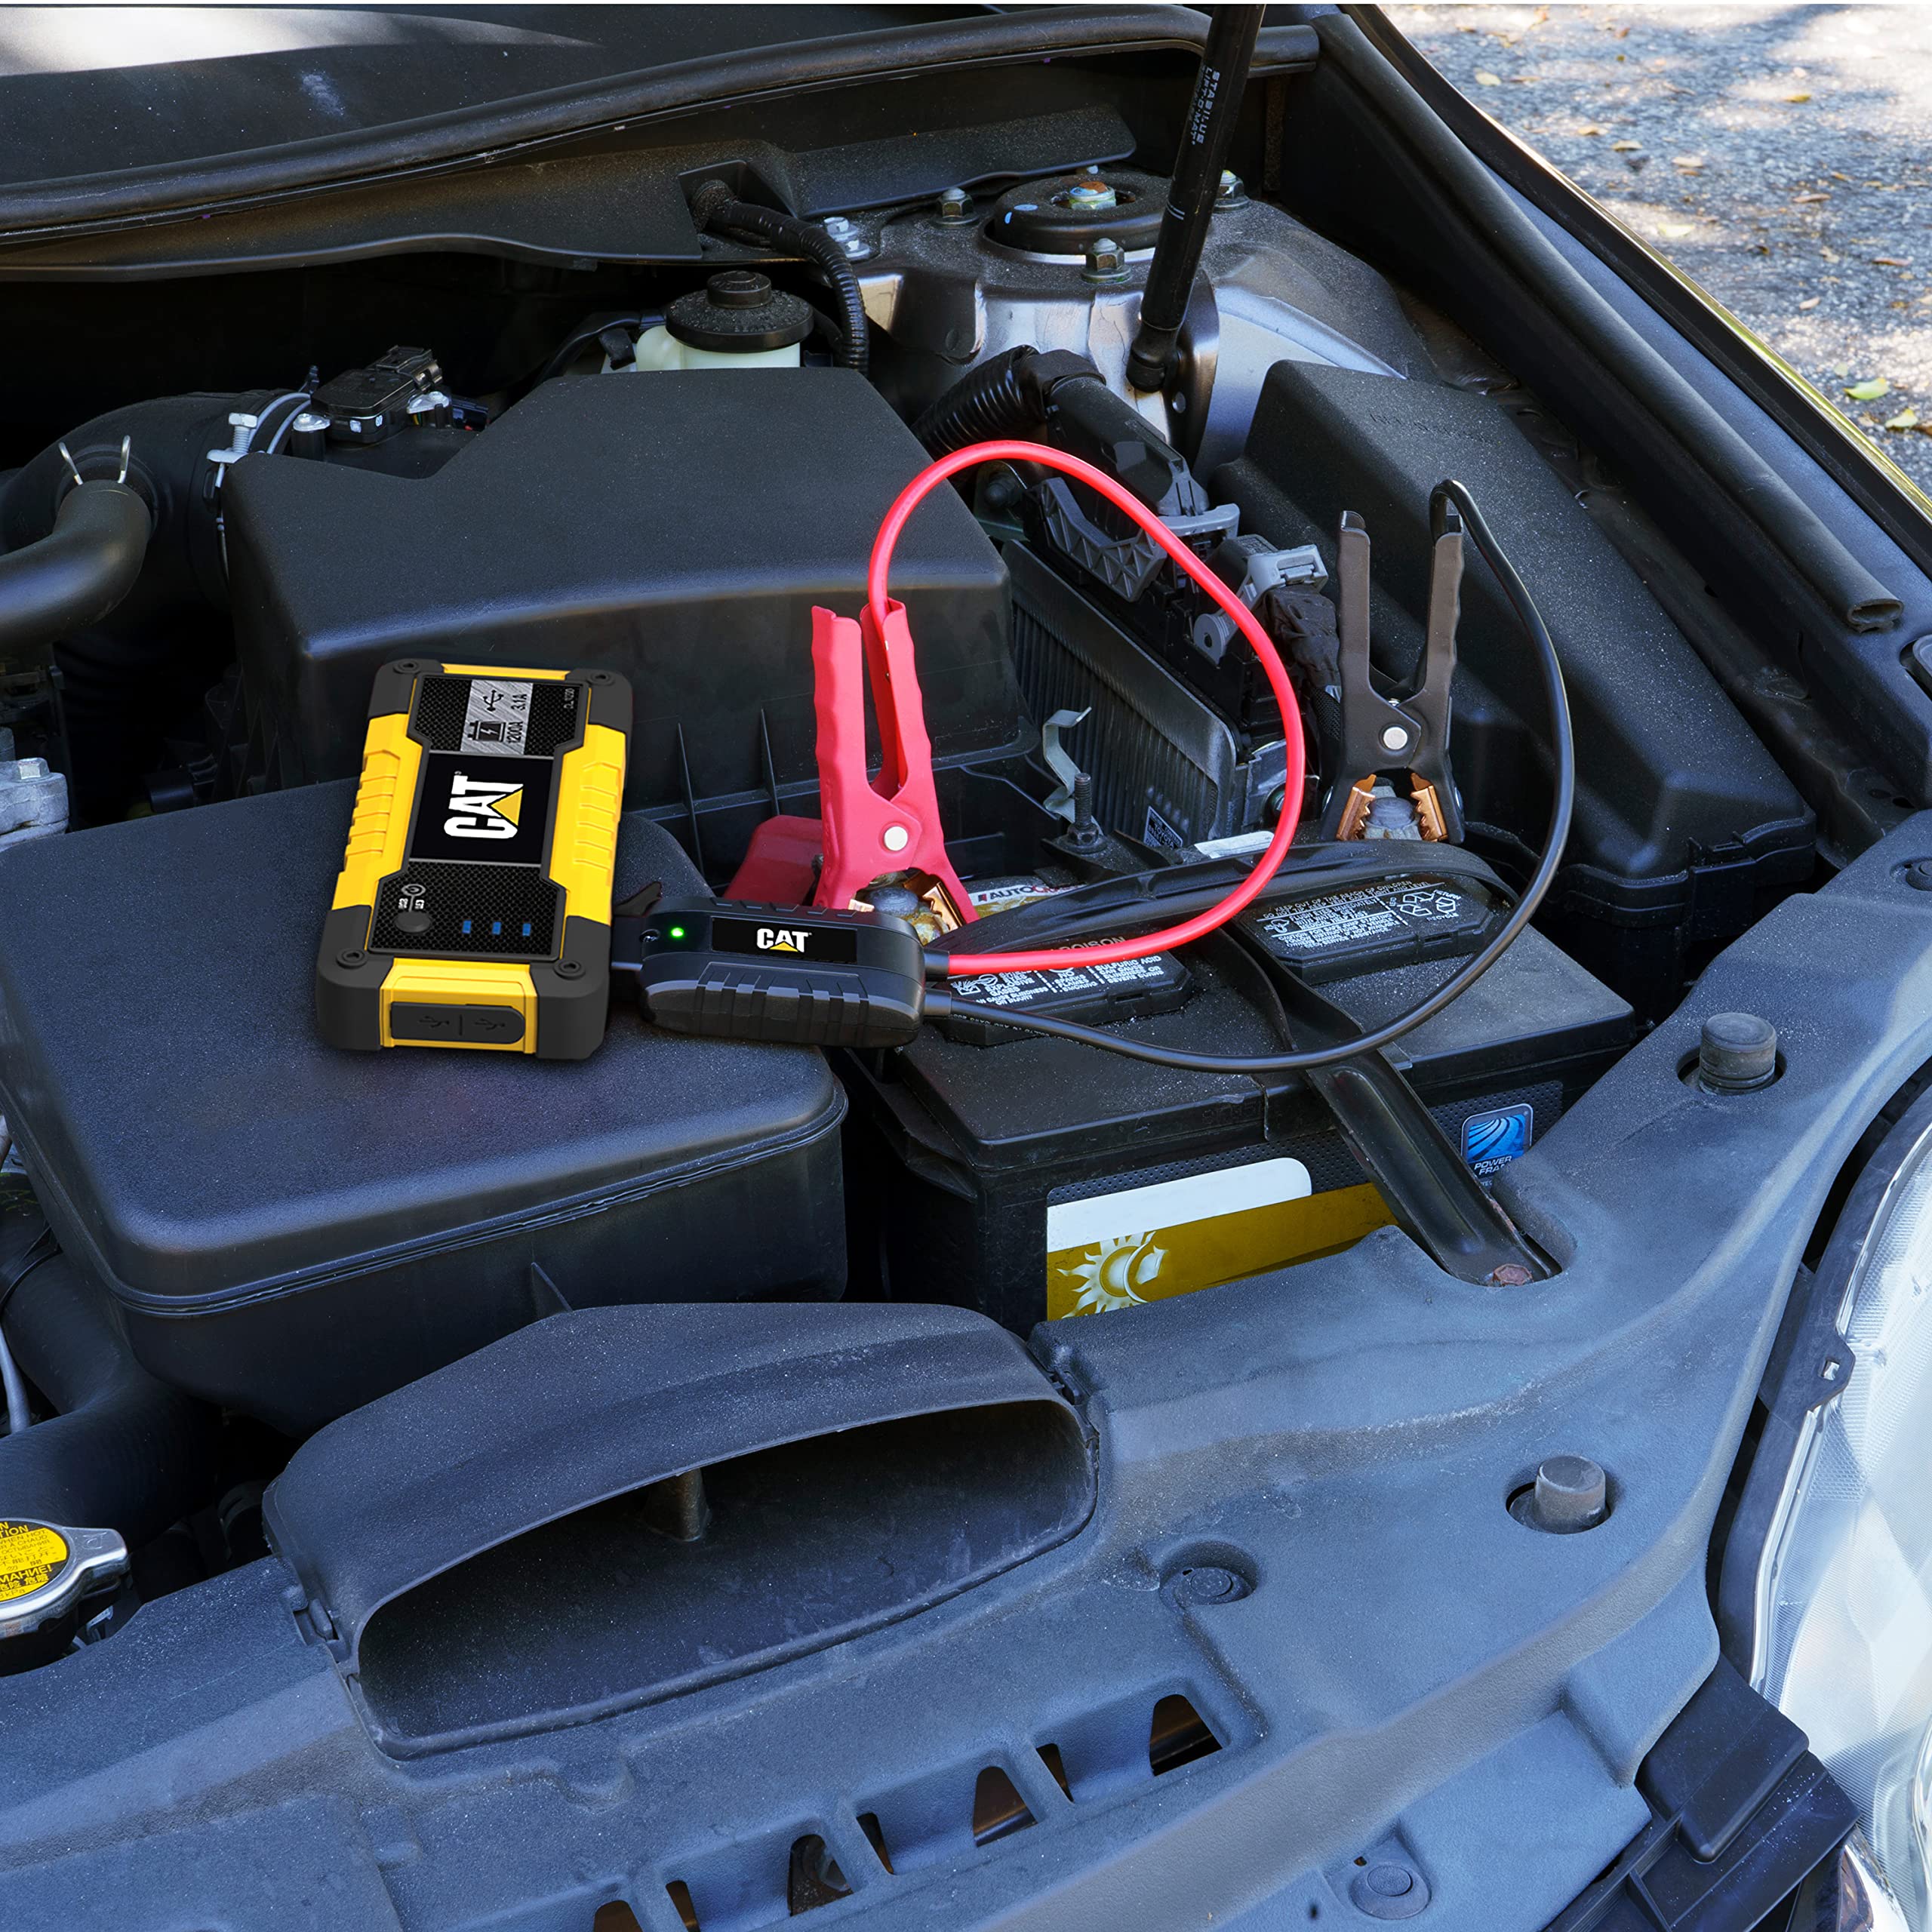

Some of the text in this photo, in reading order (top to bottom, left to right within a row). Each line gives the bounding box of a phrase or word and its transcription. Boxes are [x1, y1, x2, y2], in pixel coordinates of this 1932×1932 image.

[1196, 71, 1220, 143] STABILUS
[444, 774, 524, 839] CAT
[1433, 889, 1462, 900] RETURN
[1289, 912, 1313, 921] FLUSH
[1333, 899, 1377, 912] IMMEDIATELY
[1426, 912, 1459, 921] RECYCLE
[756, 928, 809, 952] CAT
[1059, 937, 1126, 950] OISON
[1094, 960, 1139, 971] SULFURIC
[984, 978, 1035, 991] EXPLOSIVE
[1474, 1155, 1512, 1170] POWER
